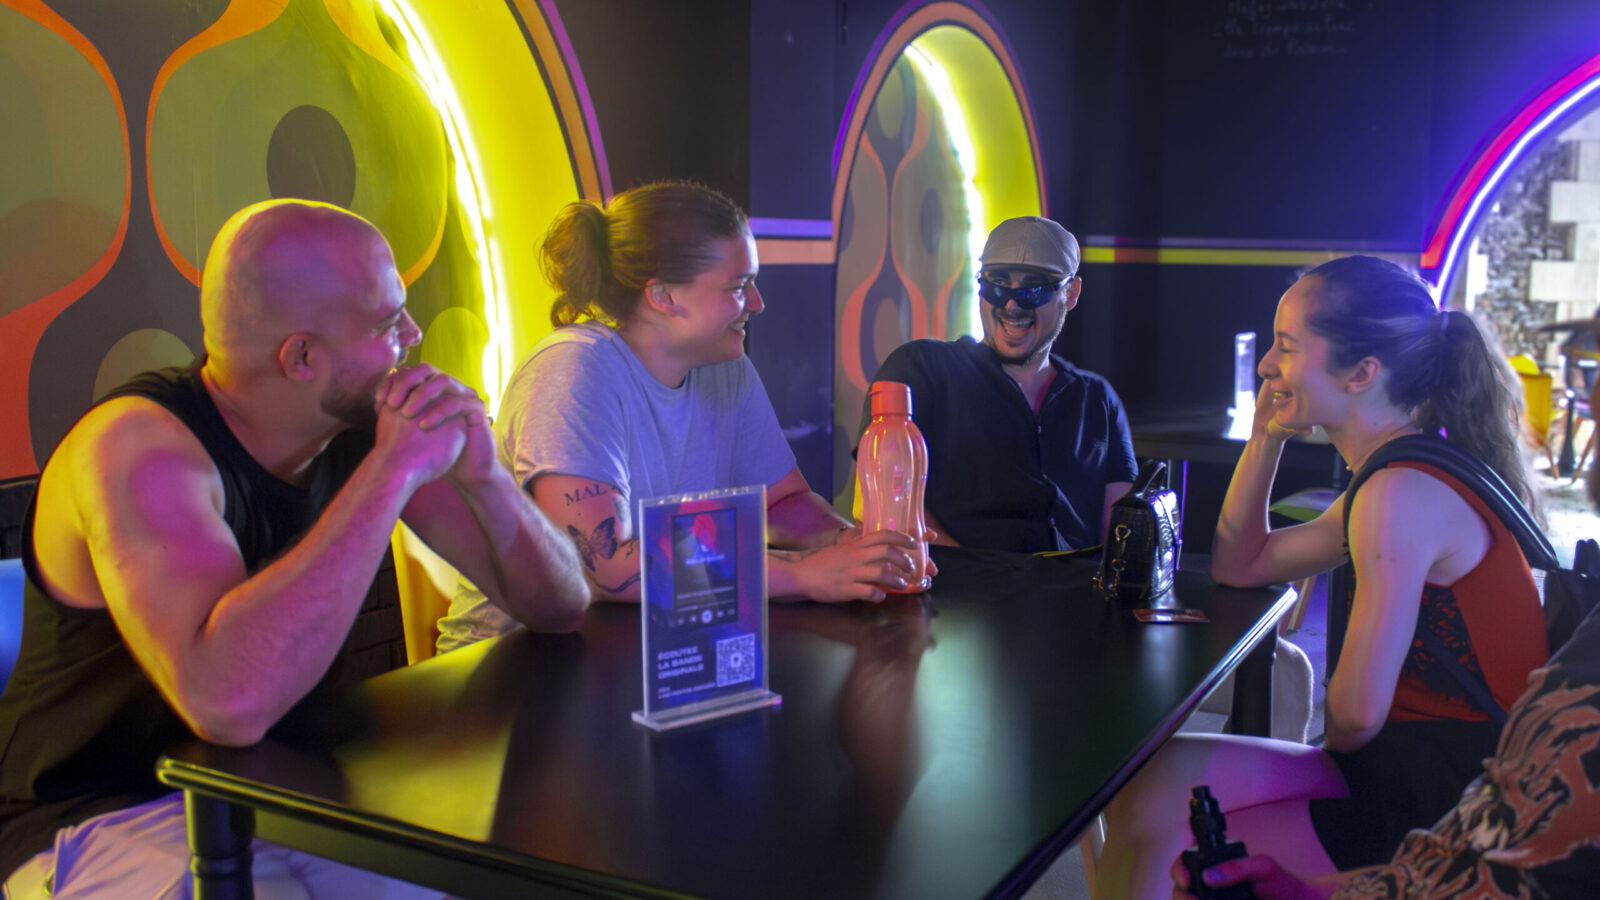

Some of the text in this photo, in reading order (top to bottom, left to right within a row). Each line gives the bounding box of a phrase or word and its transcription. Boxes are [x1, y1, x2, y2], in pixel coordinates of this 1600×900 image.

[658, 654, 703, 670] LA BANDE
[658, 663, 704, 679] ORIGINALE
